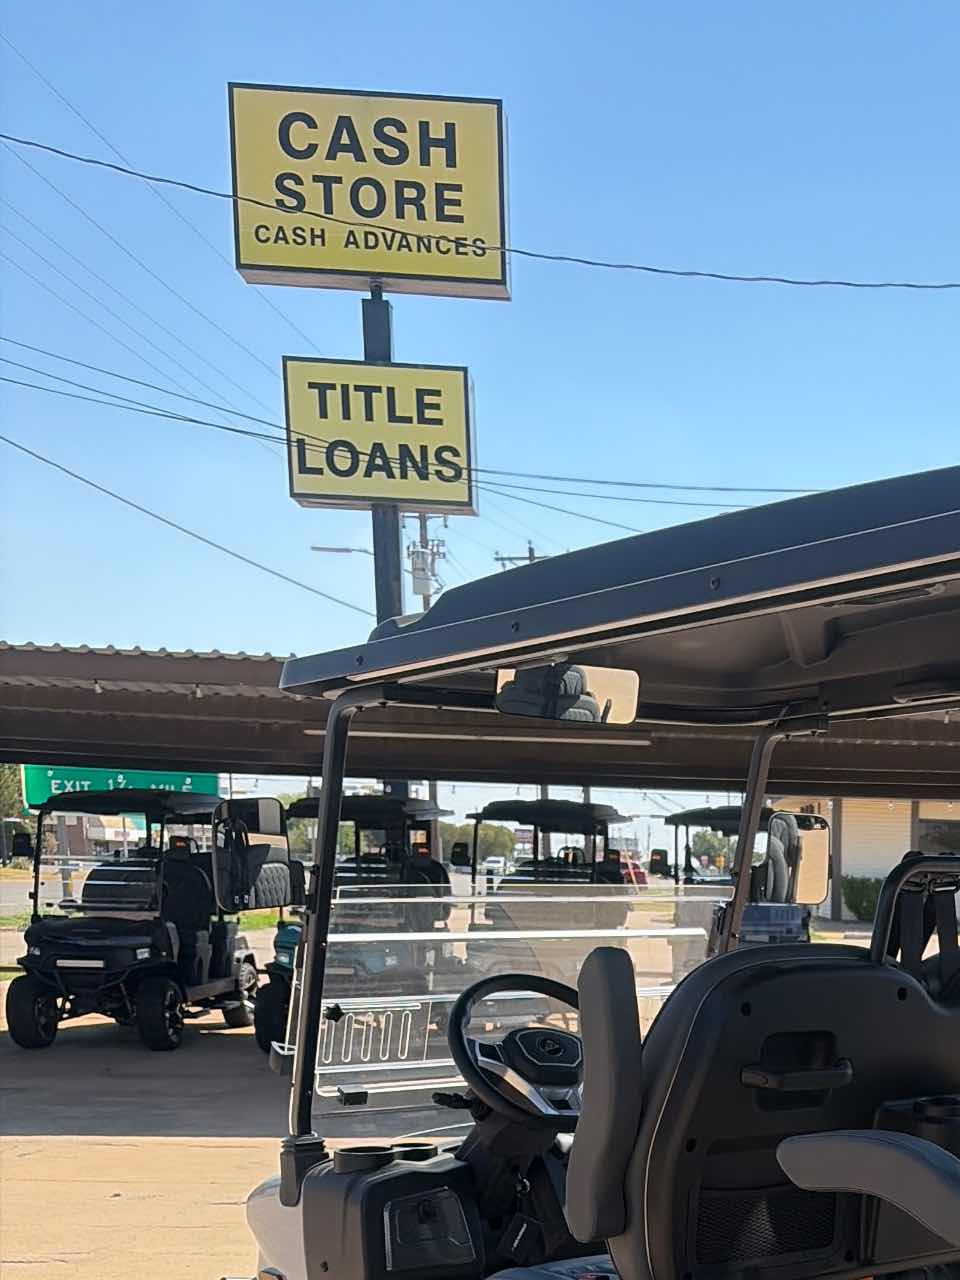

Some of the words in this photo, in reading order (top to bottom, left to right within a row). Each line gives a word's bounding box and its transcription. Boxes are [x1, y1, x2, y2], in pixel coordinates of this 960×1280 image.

[277, 111, 458, 169] CASH
[273, 171, 466, 224] STORE
[254, 224, 327, 248] CASH
[343, 230, 488, 258] ADVANCES
[307, 380, 445, 427] TITLE
[295, 437, 464, 484] LOANS
[51, 779, 92, 794] EXIT
